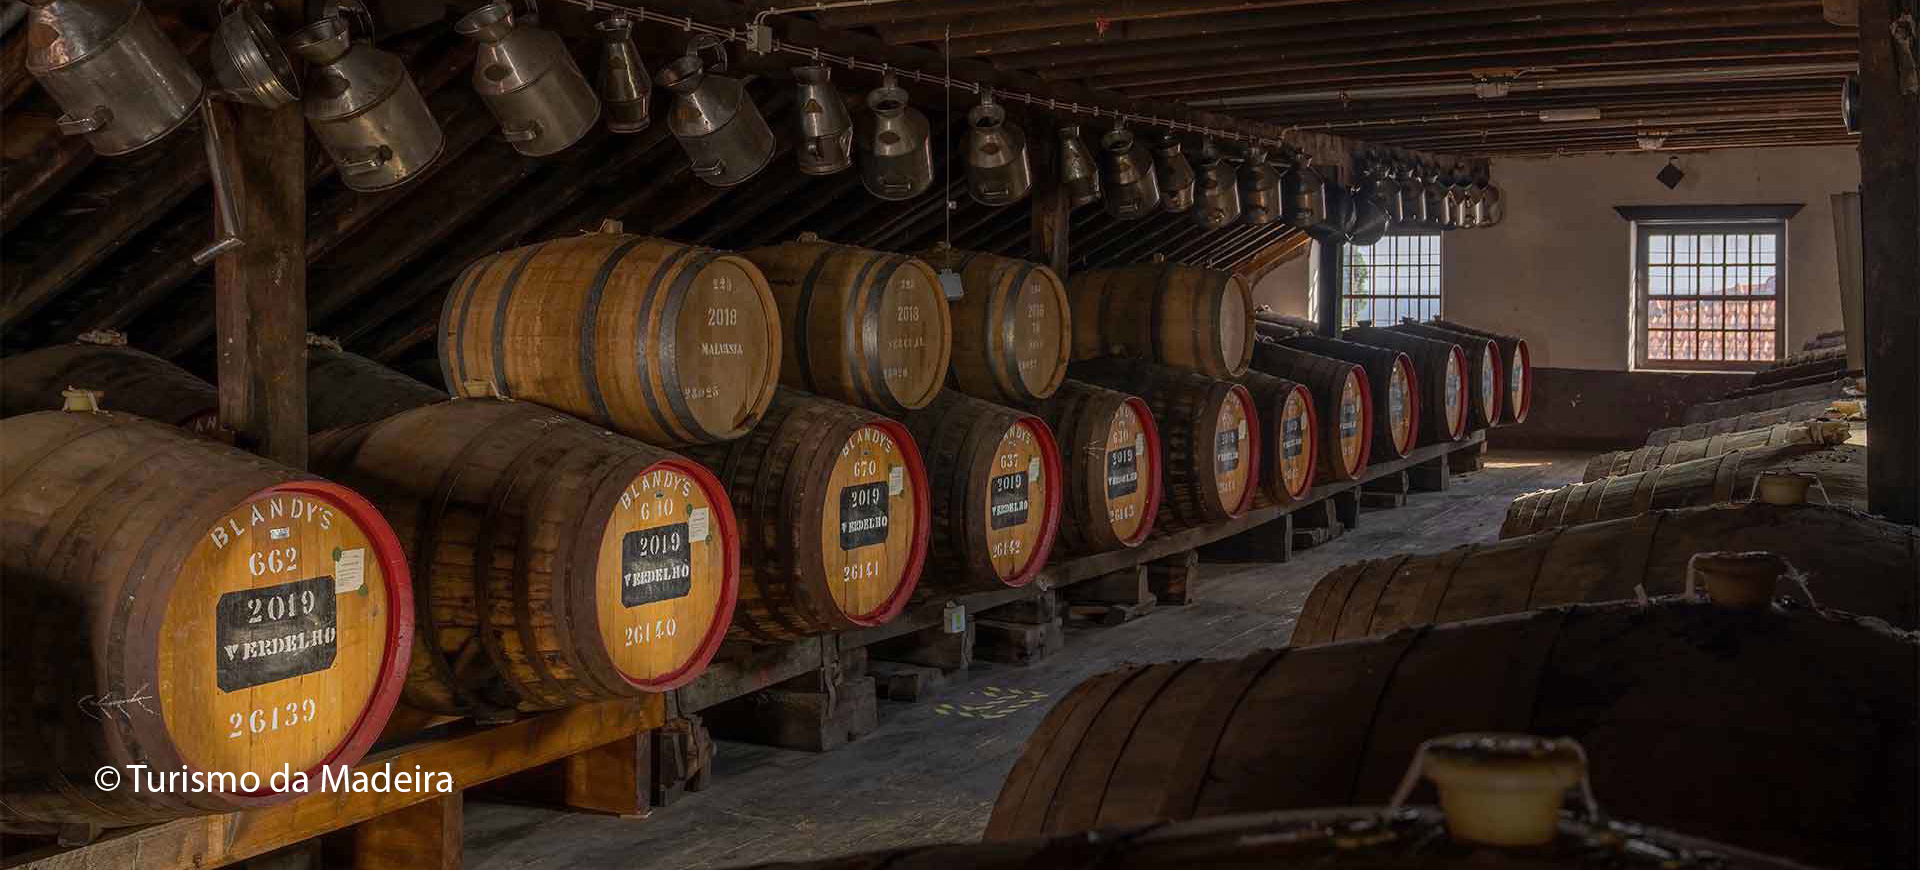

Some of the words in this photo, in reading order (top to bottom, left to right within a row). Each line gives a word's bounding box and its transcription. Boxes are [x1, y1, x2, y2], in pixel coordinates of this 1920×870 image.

[707, 307, 737, 328] 2018
[897, 305, 920, 321] 2018
[700, 342, 744, 357] MALVASIA
[842, 427, 896, 458] BLANDY'S
[1000, 454, 1019, 470] 637
[1112, 449, 1134, 466] 2019
[853, 460, 877, 478] 670
[620, 470, 692, 510] BLANDY'S
[997, 473, 1022, 492] 2019
[850, 488, 881, 509] 2019
[210, 498, 335, 551] BLANDY'S
[840, 515, 888, 534] VERDELHO
[640, 532, 681, 557] 2019
[992, 540, 1021, 558] 26142
[248, 547, 298, 576] 662
[843, 561, 879, 583] 26141
[623, 564, 690, 588] VERDELHO
[247, 590, 316, 624] 2019
[224, 626, 337, 661] VERDELHO
[625, 618, 677, 647] 26140
[228, 698, 316, 738] 26139
